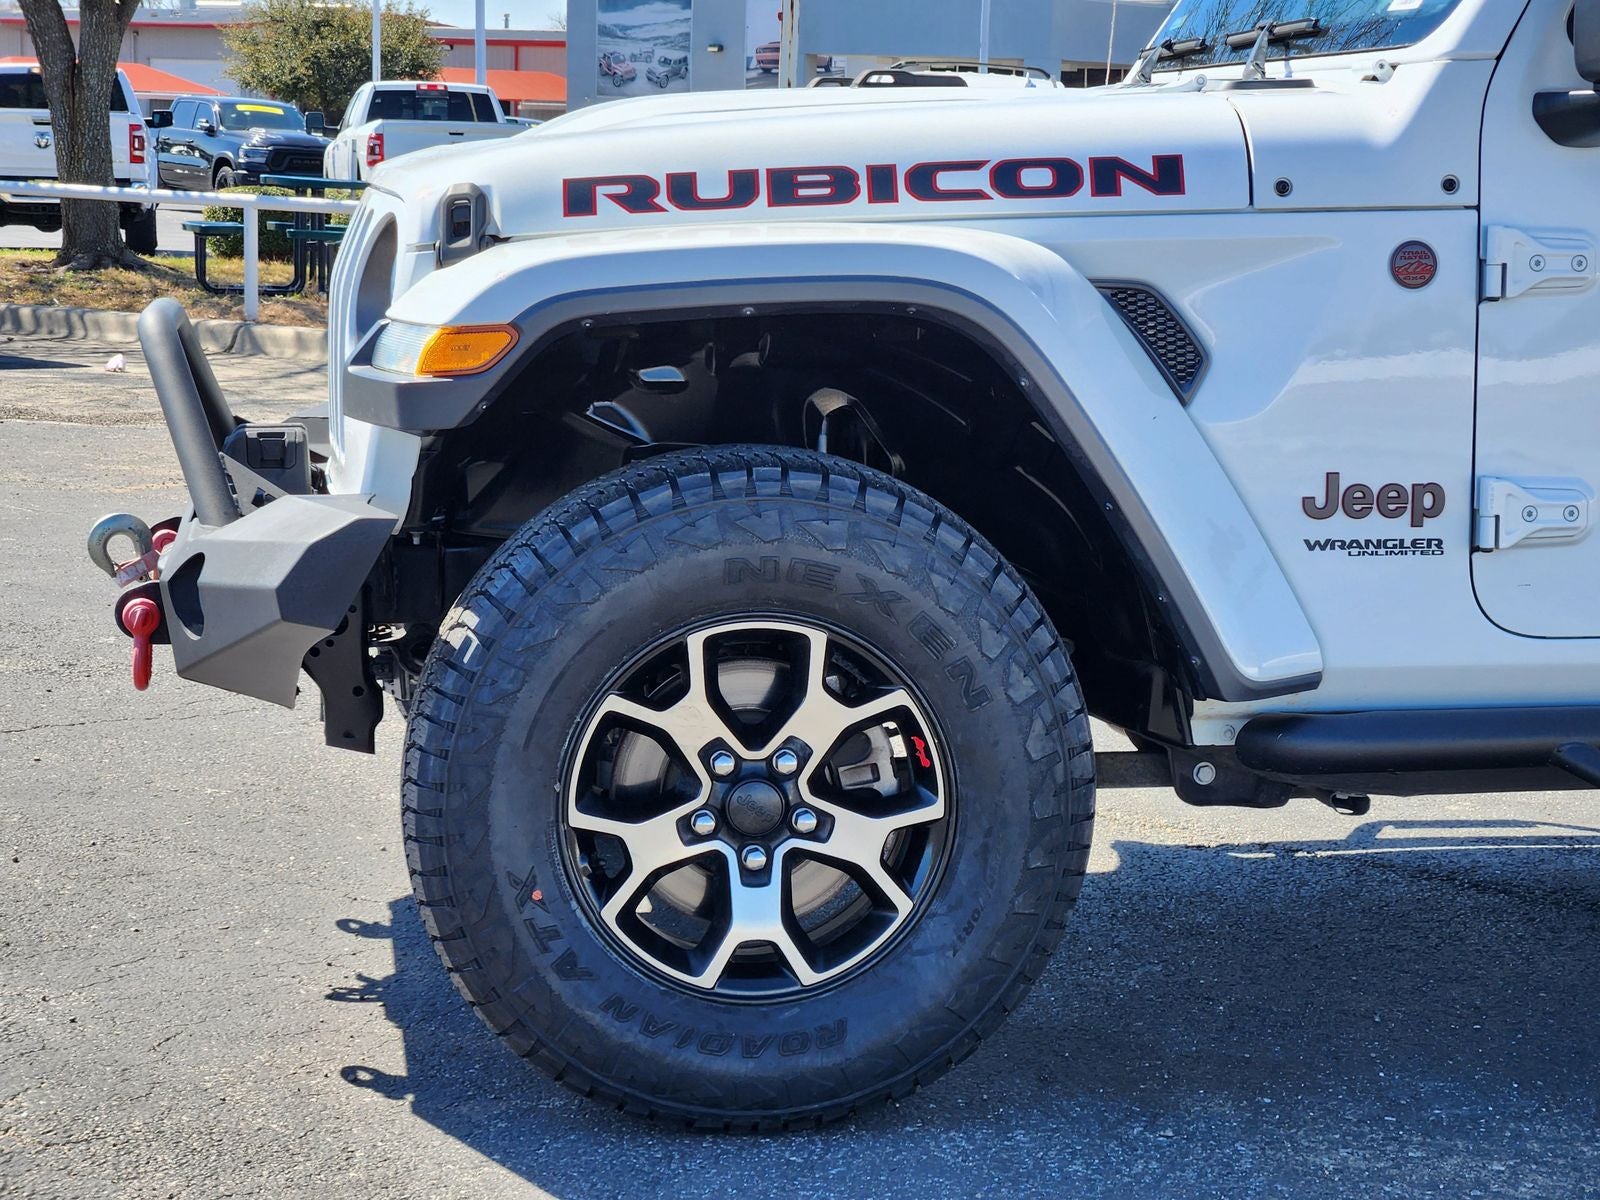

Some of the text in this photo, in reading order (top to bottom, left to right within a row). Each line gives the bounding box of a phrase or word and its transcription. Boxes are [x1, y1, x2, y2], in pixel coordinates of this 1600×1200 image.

[562, 153, 1186, 217] RUBICON
[1302, 471, 1446, 528] Jeep
[1303, 538, 1444, 551] WRANGLER
[1347, 549, 1445, 557] UNLIMITED
[723, 555, 994, 713] NEXEN
[505, 865, 849, 1059] ROADIAN ATX
